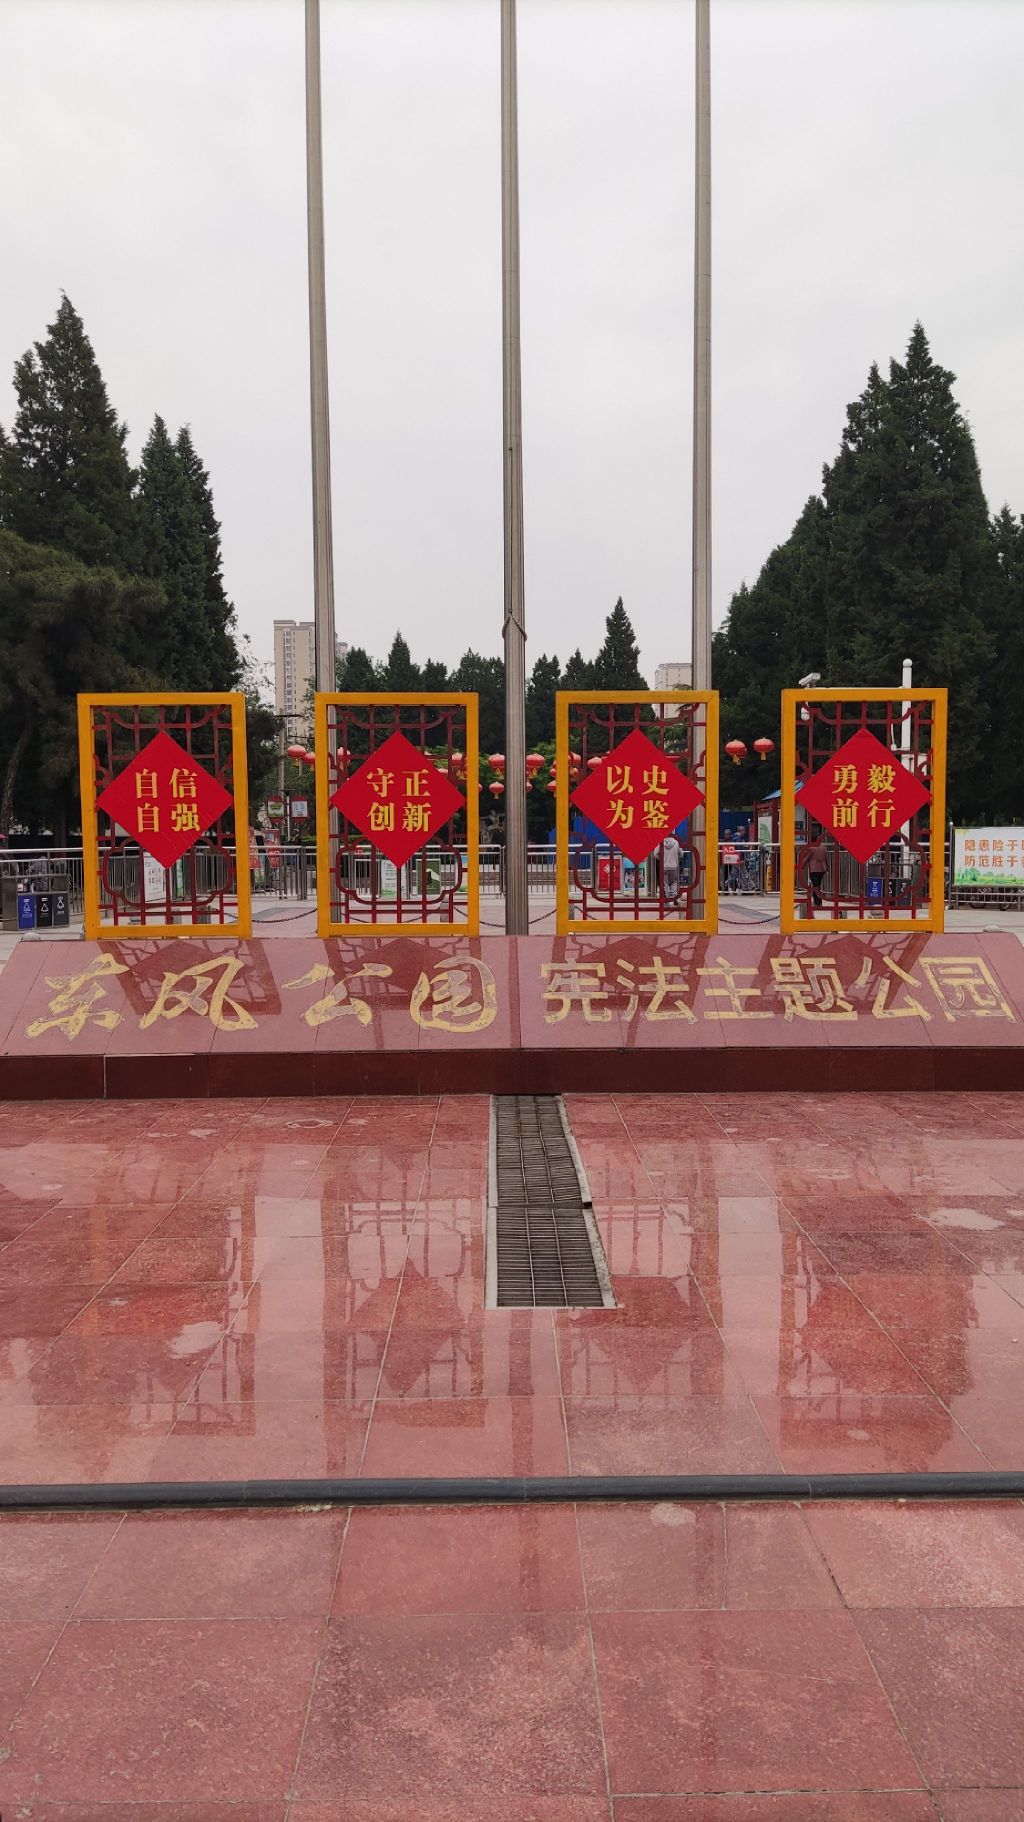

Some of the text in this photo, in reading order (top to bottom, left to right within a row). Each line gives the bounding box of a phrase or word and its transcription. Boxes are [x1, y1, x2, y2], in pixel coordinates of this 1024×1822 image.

[135, 769, 198, 799] 自信
[367, 768, 431, 797] 守正
[606, 765, 669, 795] 以史
[832, 764, 897, 794] 勇毅
[136, 804, 200, 833] 自强
[367, 803, 432, 832] 创新
[606, 800, 670, 829] 为鉴
[831, 799, 897, 828] 前行
[964, 839, 1024, 851] 隐患险于
[964, 855, 1024, 867] 防范胜于
[539, 955, 1018, 1025] 宪法主题公园
